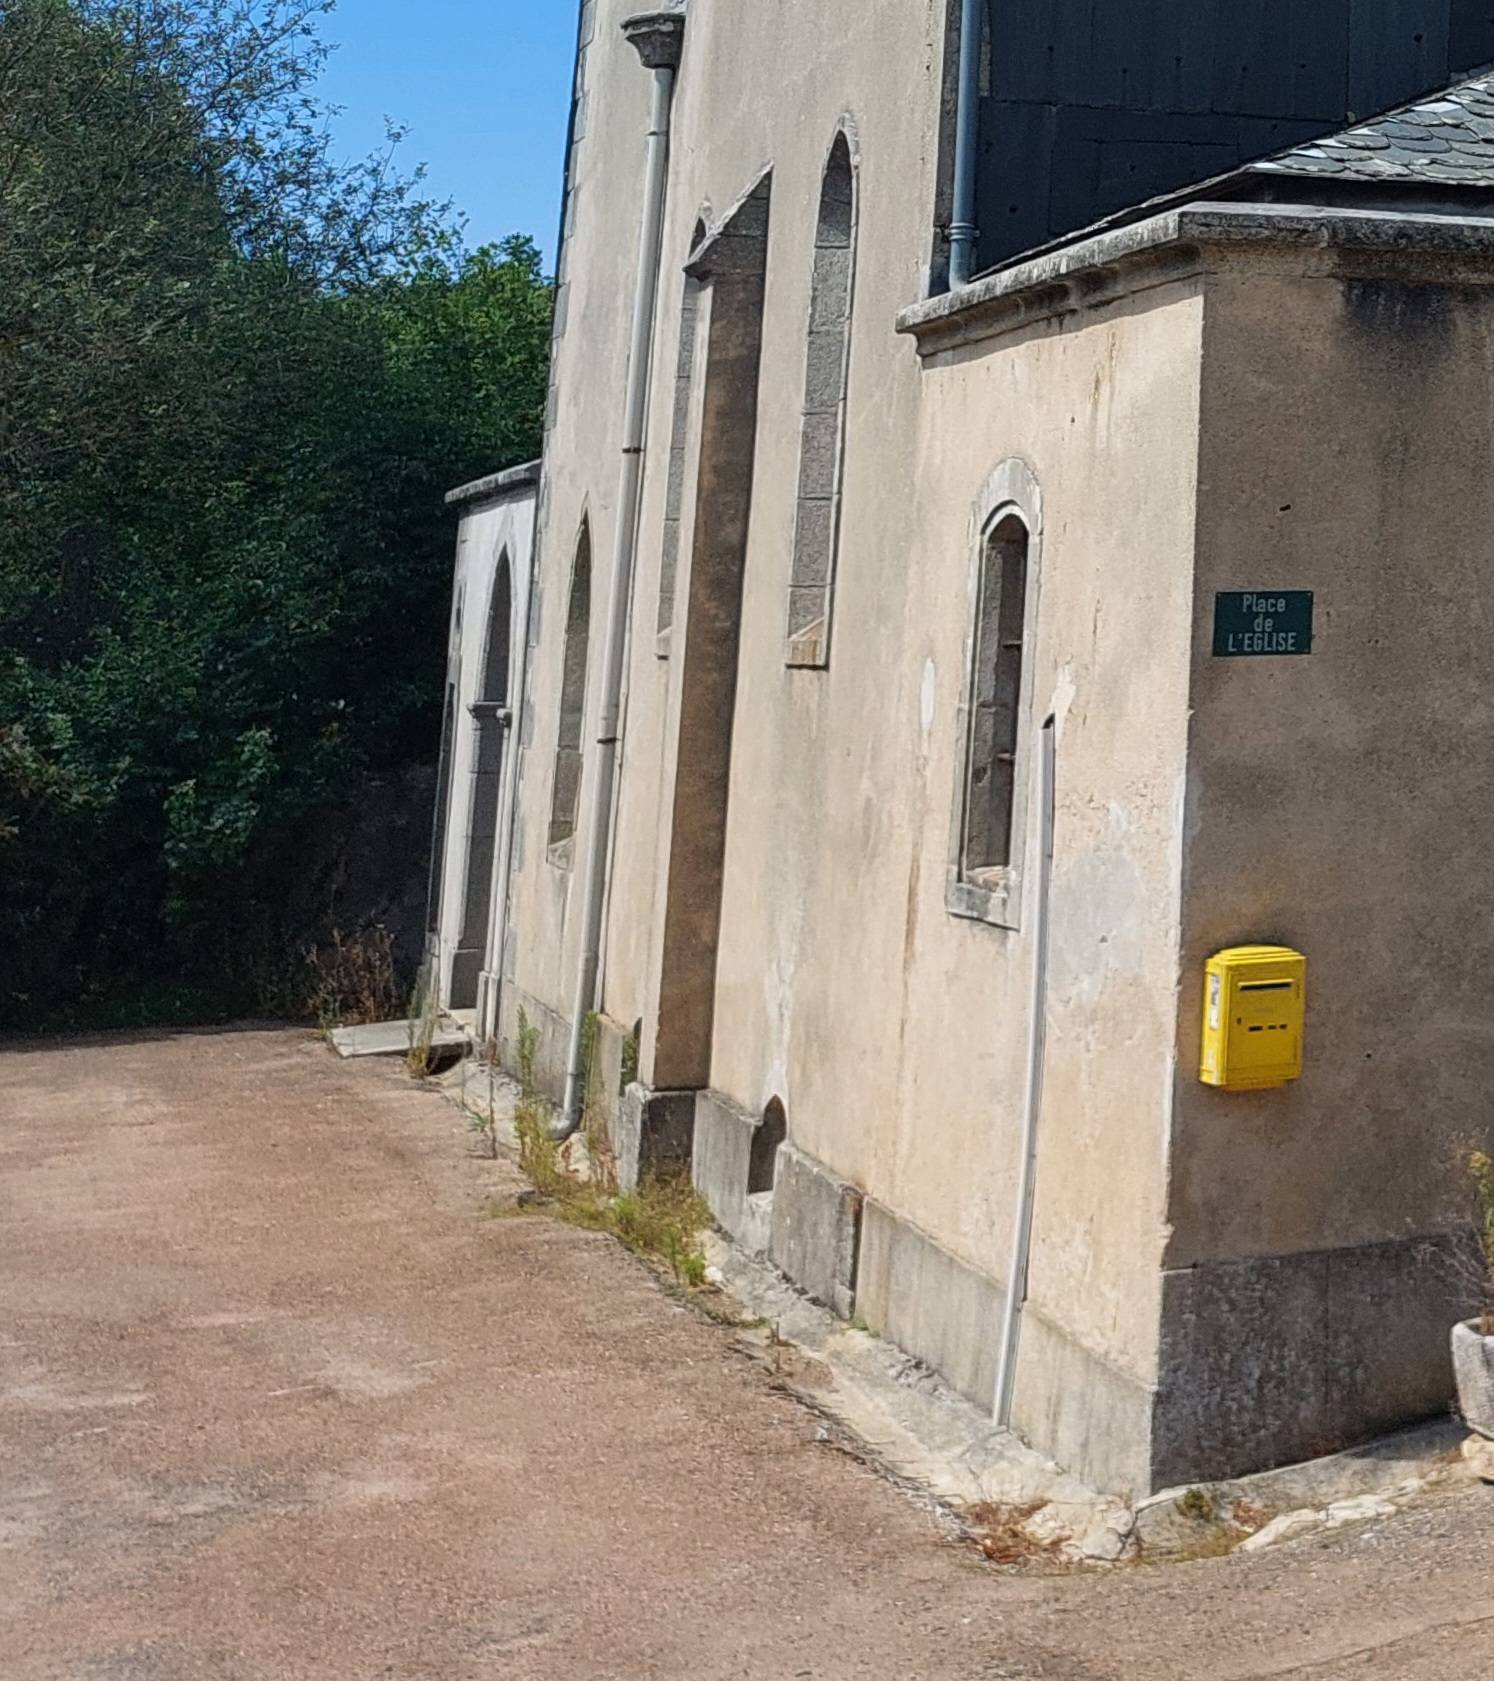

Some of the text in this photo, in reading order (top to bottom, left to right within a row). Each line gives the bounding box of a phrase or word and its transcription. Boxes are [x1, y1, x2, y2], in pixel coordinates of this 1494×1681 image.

[1242, 594, 1286, 613] Place
[1253, 613, 1273, 631] de
[1227, 632, 1297, 652] L'EGLISE
